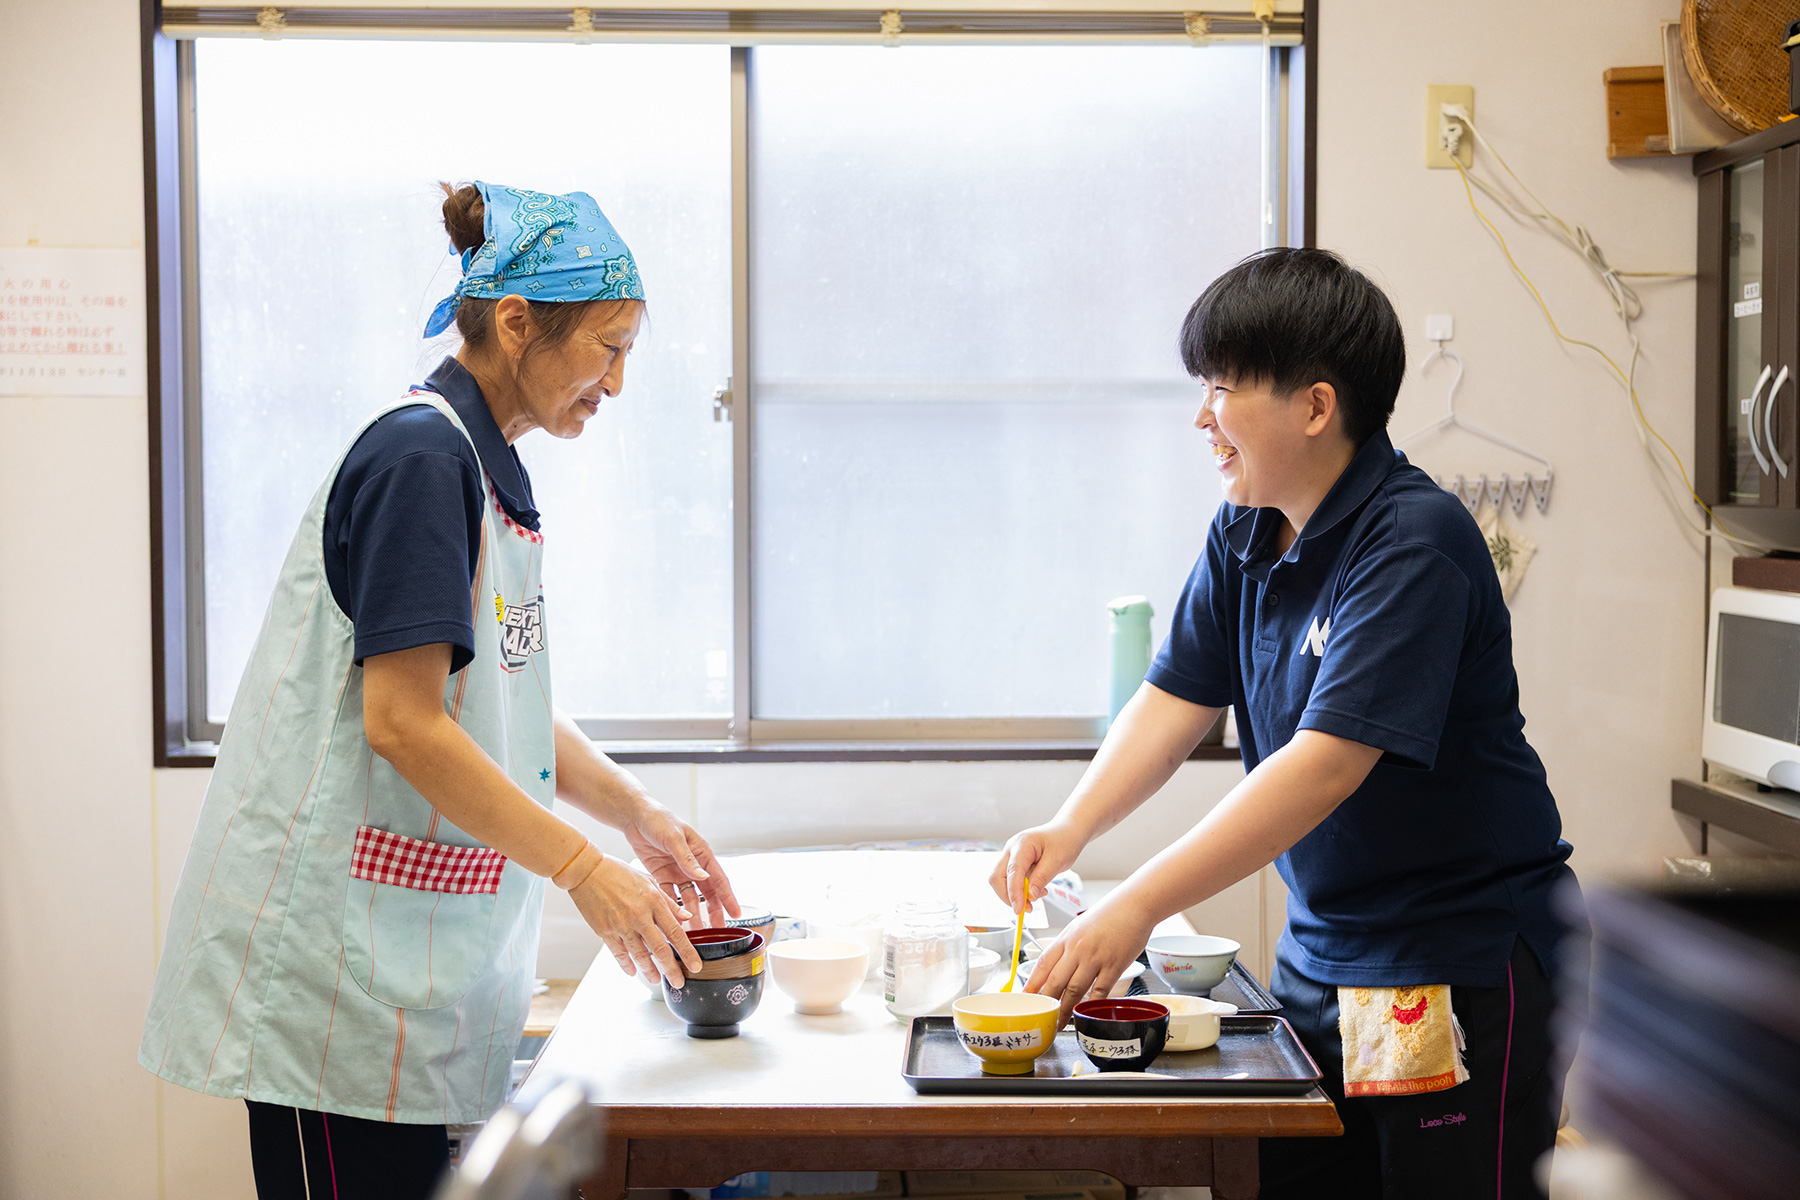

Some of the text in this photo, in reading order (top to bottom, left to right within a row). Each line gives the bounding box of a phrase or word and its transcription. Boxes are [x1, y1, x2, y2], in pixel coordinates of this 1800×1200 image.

[1408, 1080, 1426, 1090] the
[1426, 1075, 1453, 1090] pooh
[1442, 1112, 1467, 1126] Style
